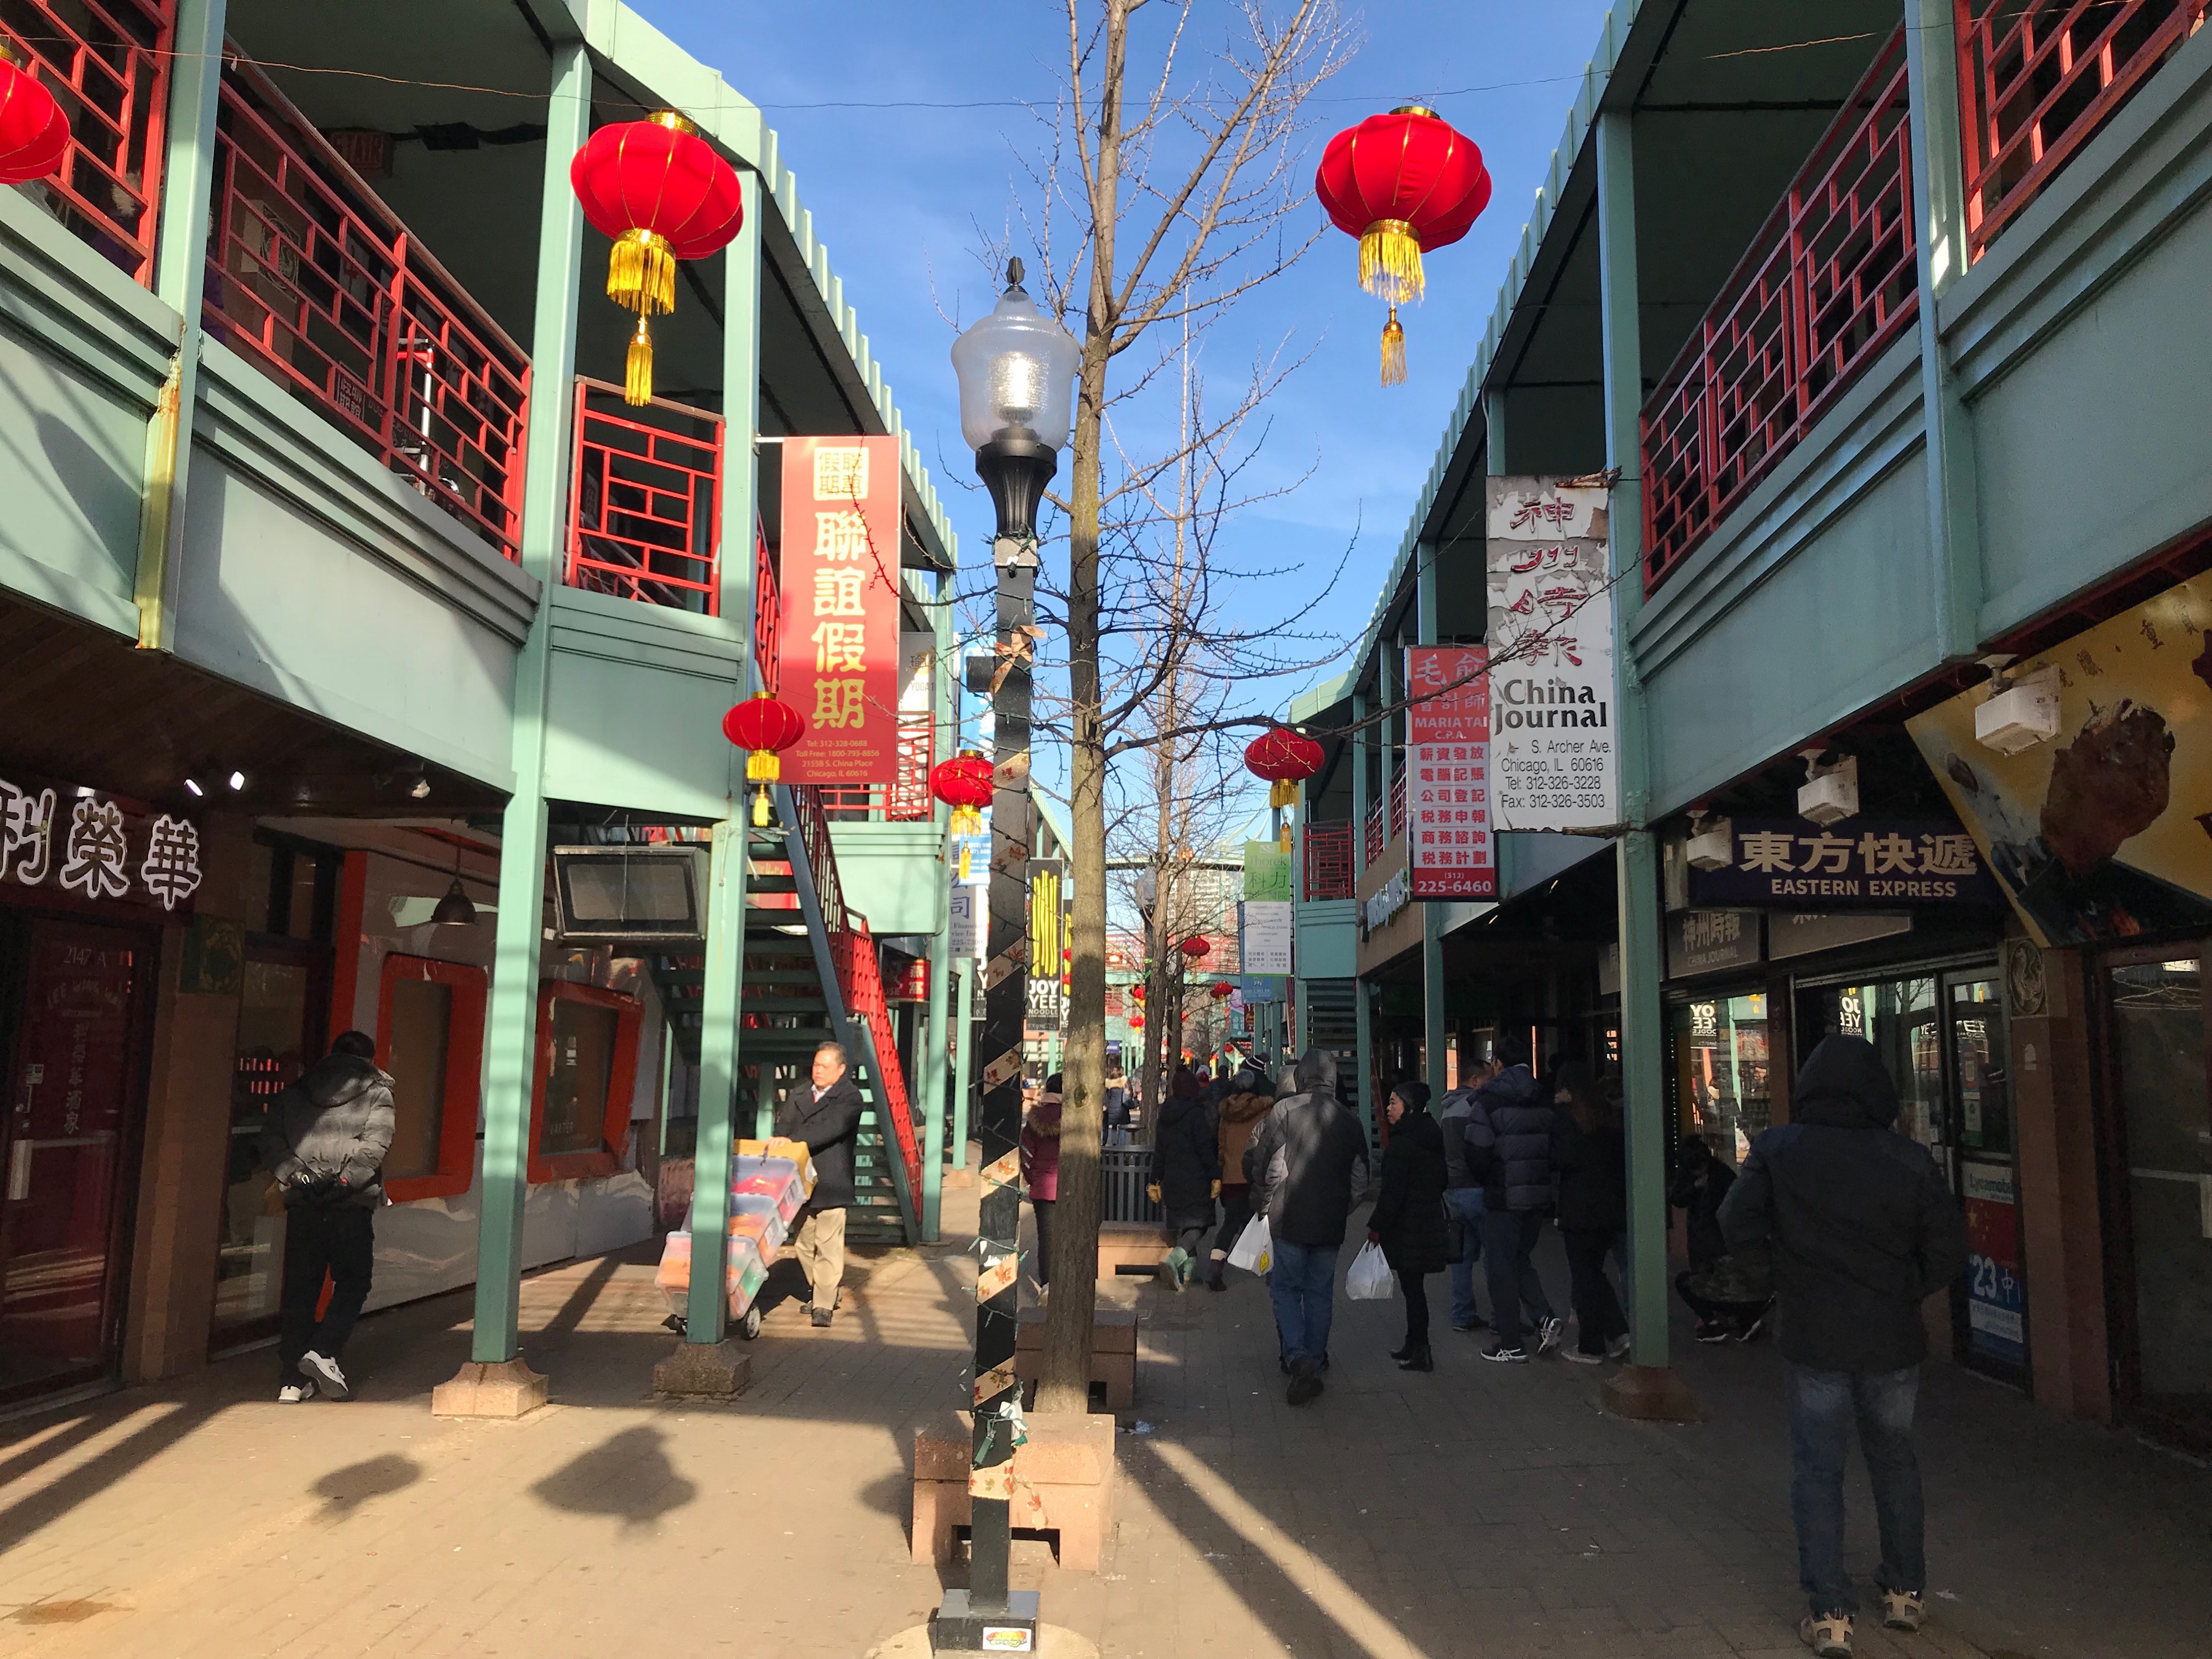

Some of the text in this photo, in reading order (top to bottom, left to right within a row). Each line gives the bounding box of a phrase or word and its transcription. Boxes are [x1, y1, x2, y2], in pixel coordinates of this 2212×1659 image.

[811, 510, 867, 729] 聯誼假期
[911, 682, 929, 691] YOGA
[1503, 678, 1596, 705] China
[1415, 716, 1488, 728] MARIA TAI
[1494, 702, 1608, 736] Journal
[1434, 730, 1467, 739] C.P.A.
[1420, 746, 1484, 761] 薪資發放
[1531, 739, 1541, 754] S.
[1547, 739, 1585, 754] Archer
[1589, 739, 1611, 754] Ave.
[1501, 758, 1604, 774] Chicago, IL 60616
[806, 770, 837, 779] Chicago,
[1505, 776, 1601, 790] Tel: 312-326-3228
[1421, 789, 1485, 802] 公司登記
[1501, 794, 1605, 808] Fax: 312-326-3503
[0, 779, 202, 912] 利榮華
[1738, 831, 1978, 875] 東方快遞
[1249, 855, 1287, 867] Thorek
[1249, 872, 1286, 889] 科力
[1418, 880, 1492, 893] 225-6460
[1771, 879, 1957, 897] EASTERN EXPRESS
[62, 945, 106, 968] 2147 A
[1707, 946, 1739, 964] JOURNAL
[1029, 979, 1060, 995] JOY
[1028, 994, 1058, 1009] YEE
